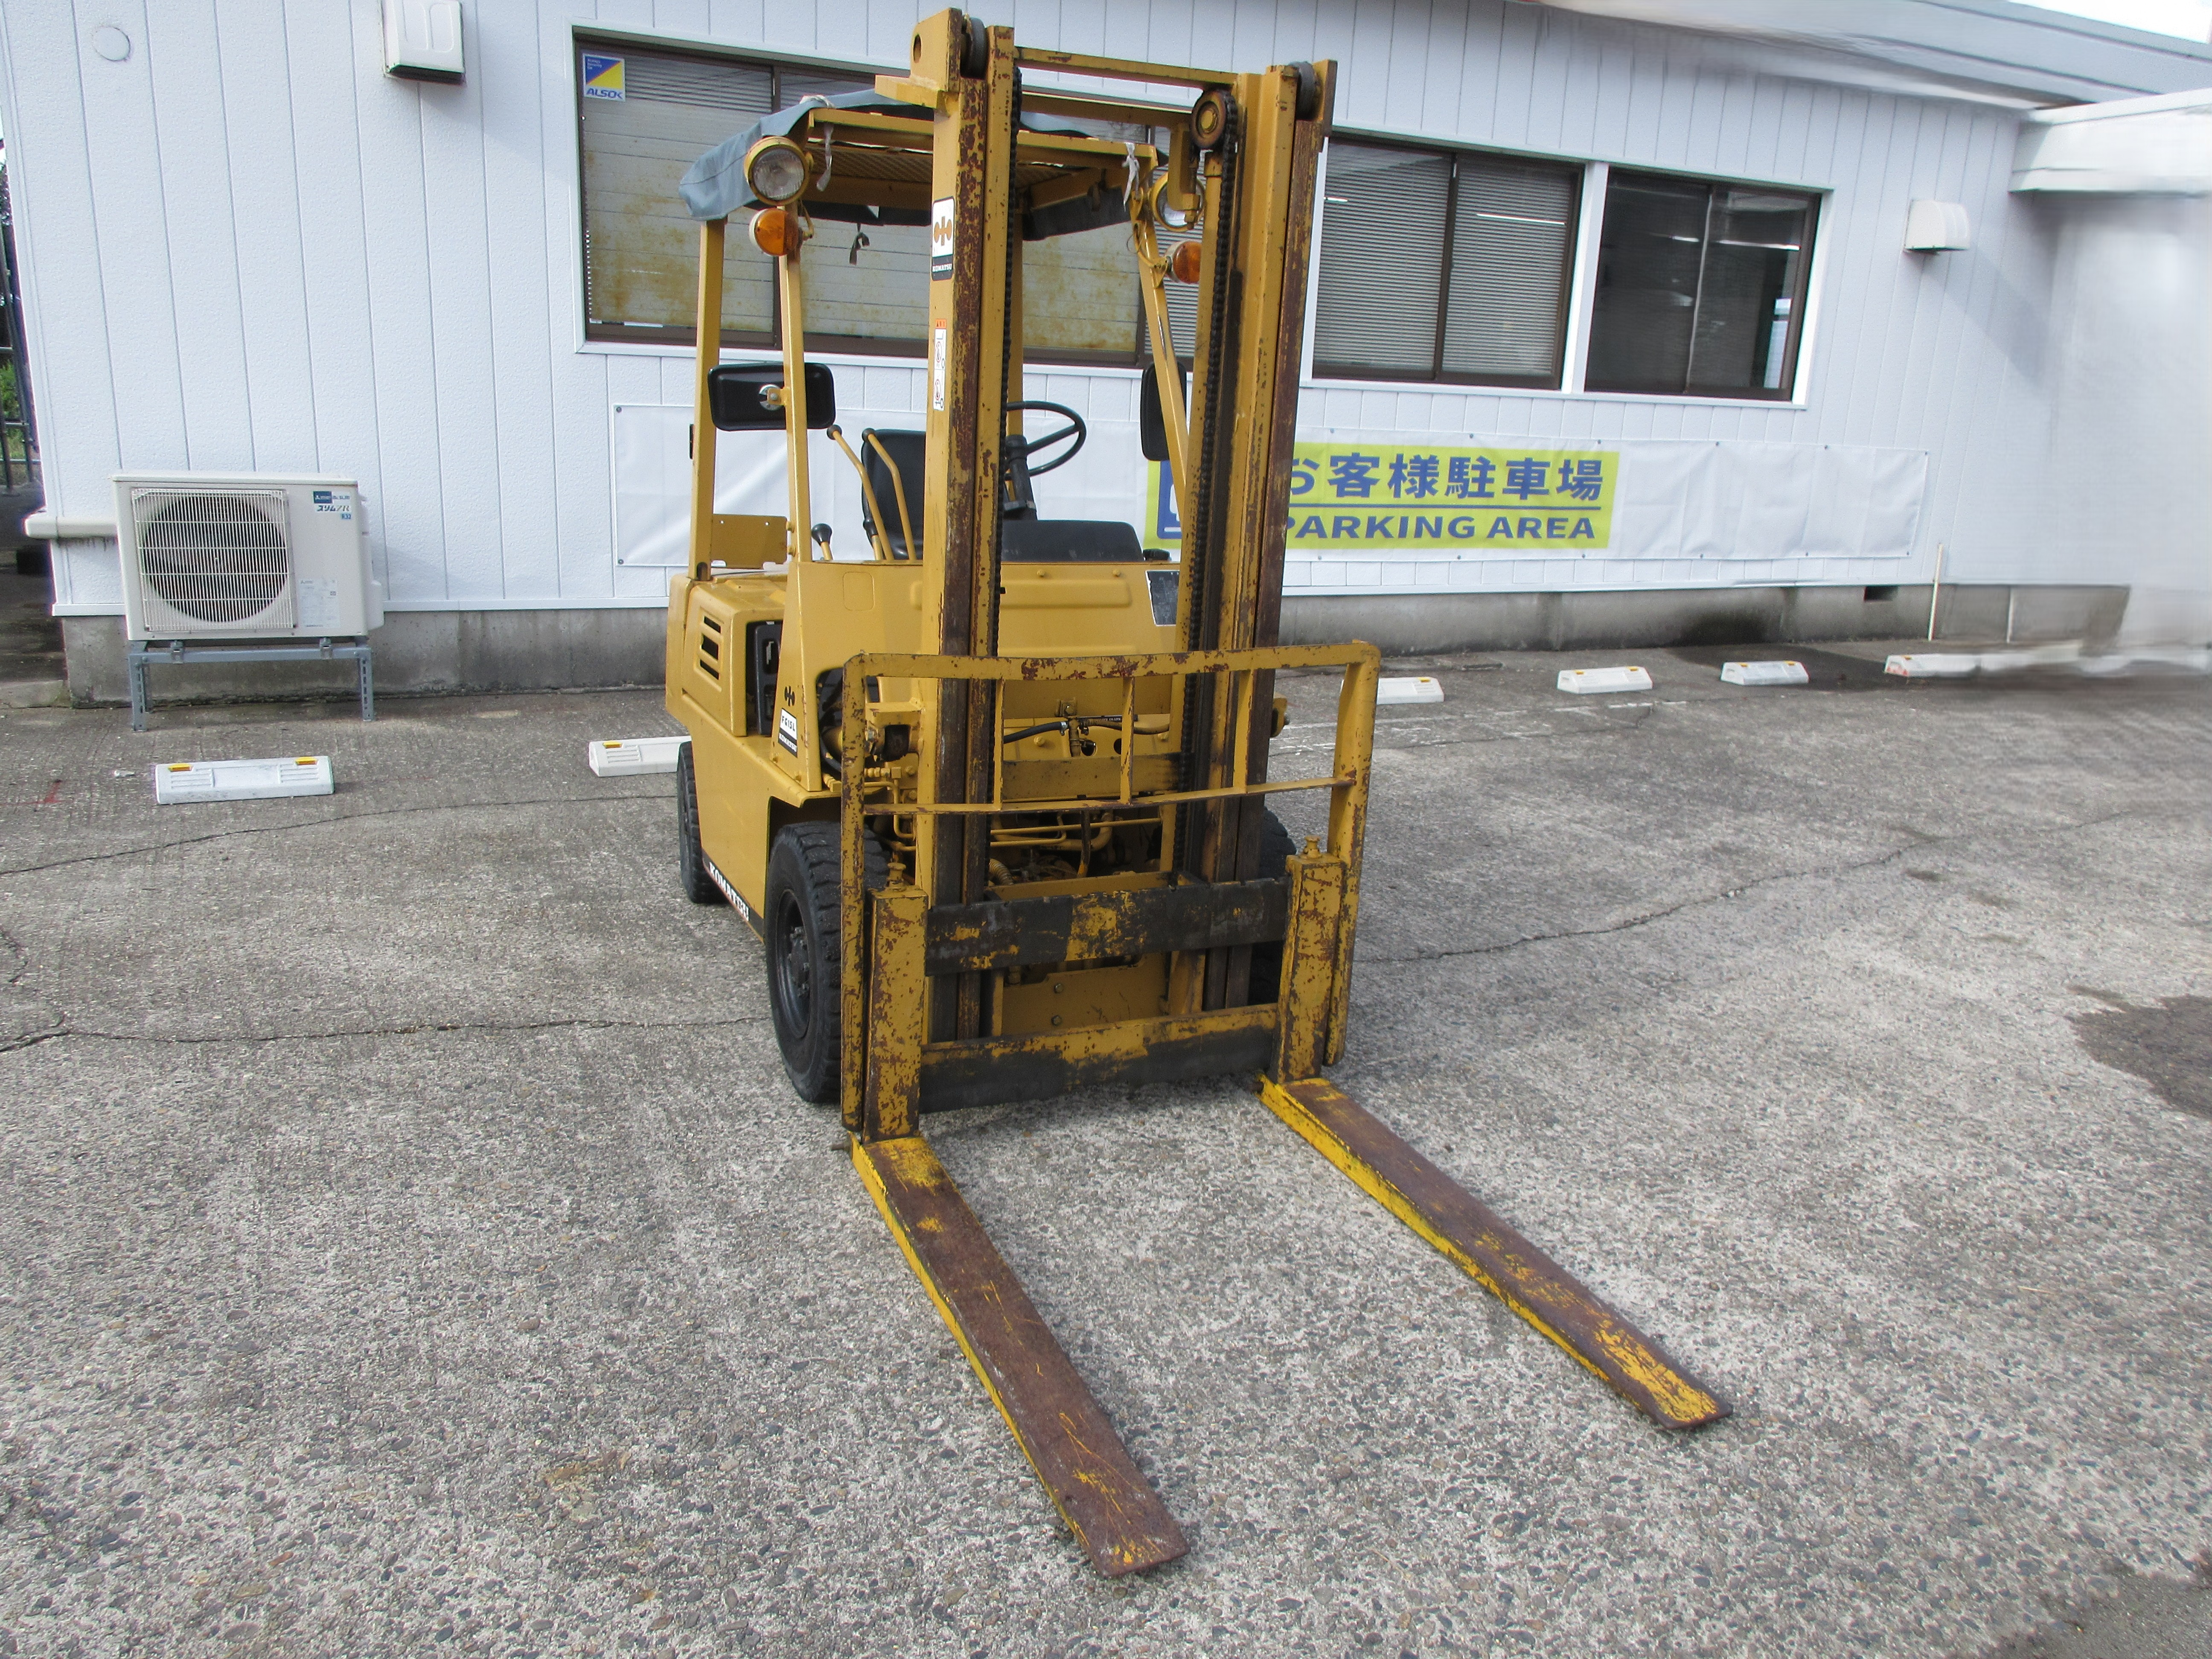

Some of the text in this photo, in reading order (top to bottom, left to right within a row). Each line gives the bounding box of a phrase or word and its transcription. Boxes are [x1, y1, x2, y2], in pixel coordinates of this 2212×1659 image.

[587, 87, 623, 99] ALSOK
[932, 263, 952, 272] KOMATSU
[1486, 516, 1595, 539] AREA
[782, 716, 795, 732] FG15L
[779, 733, 797, 752] KOMATSU
[709, 862, 749, 922] KOMATSU
